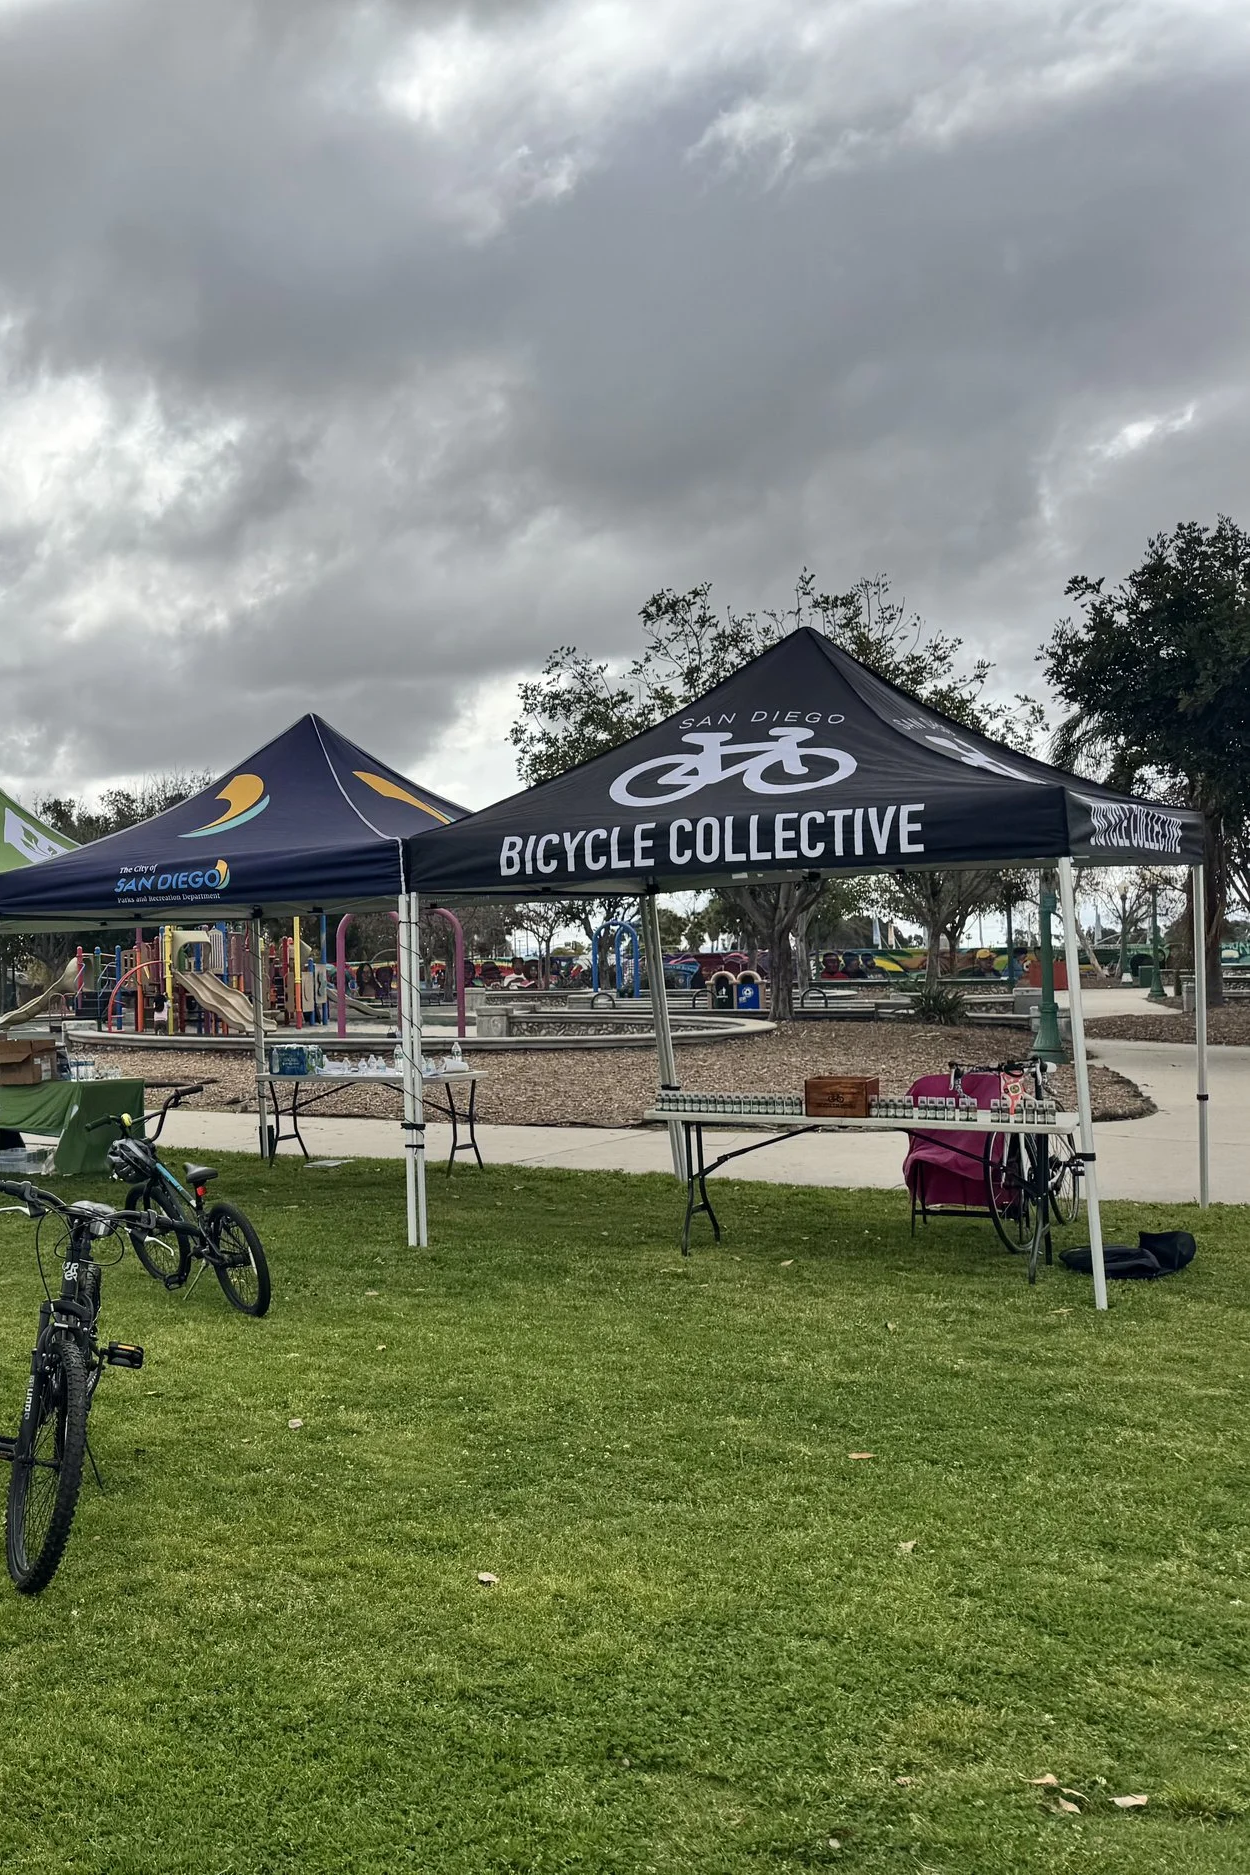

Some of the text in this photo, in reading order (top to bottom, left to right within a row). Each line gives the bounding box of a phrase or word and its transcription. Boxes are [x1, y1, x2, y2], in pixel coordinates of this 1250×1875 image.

[678, 710, 847, 730] SAN DIEGO
[499, 803, 926, 877] BICYCLE COLLECTIVE
[119, 863, 159, 874] The City of
[114, 869, 222, 893] SAN DIEGO
[135, 895, 148, 903] and
[148, 893, 182, 902] Recreation
[182, 892, 221, 902] Department
